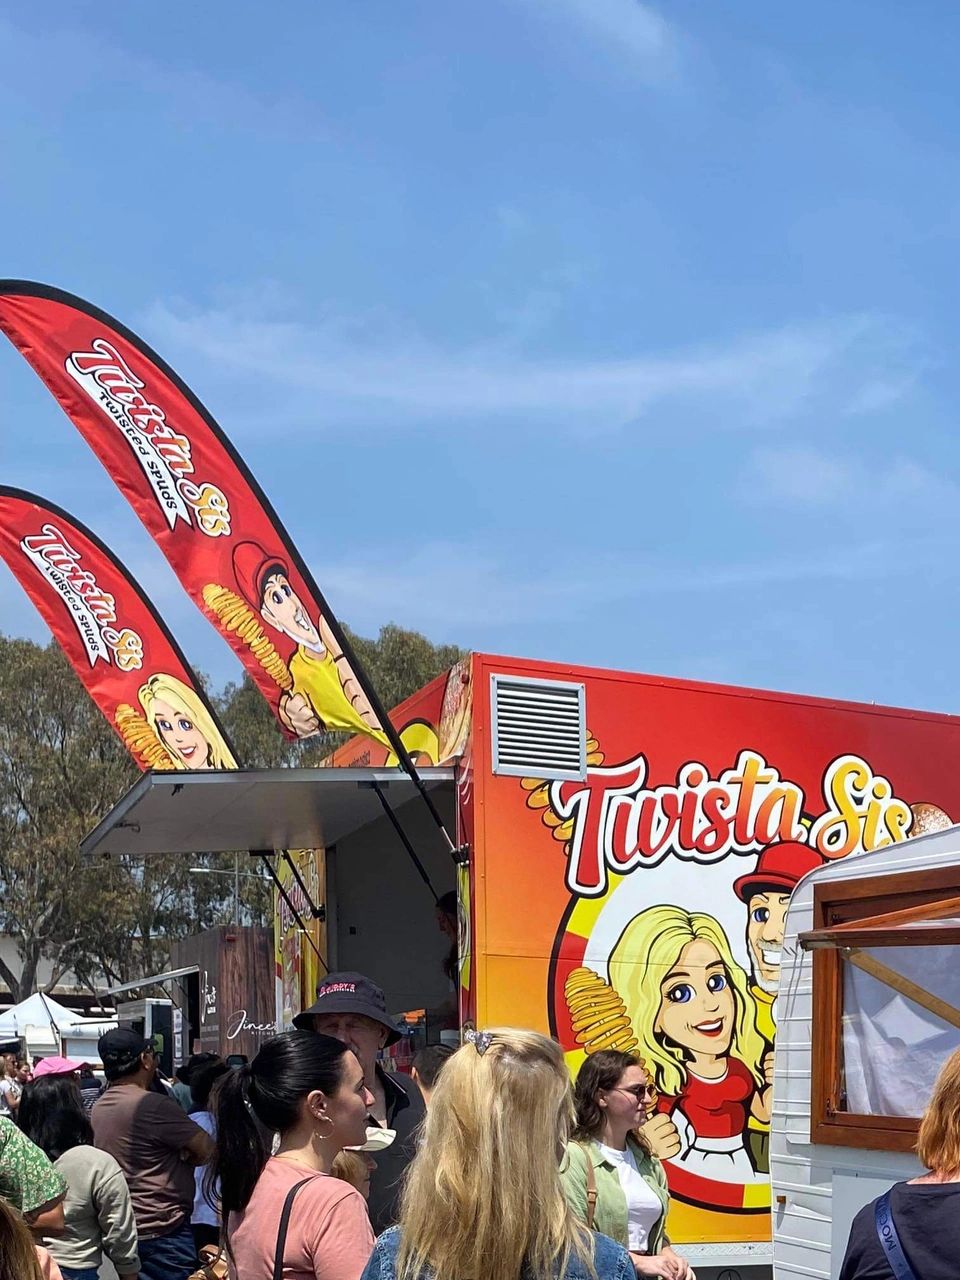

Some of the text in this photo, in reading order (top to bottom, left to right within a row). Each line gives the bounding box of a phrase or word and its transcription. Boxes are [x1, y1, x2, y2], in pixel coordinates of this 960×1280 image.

[72, 339, 232, 538] Twista Sis
[25, 524, 117, 627] Twista
[556, 750, 909, 890] Twista Sis
